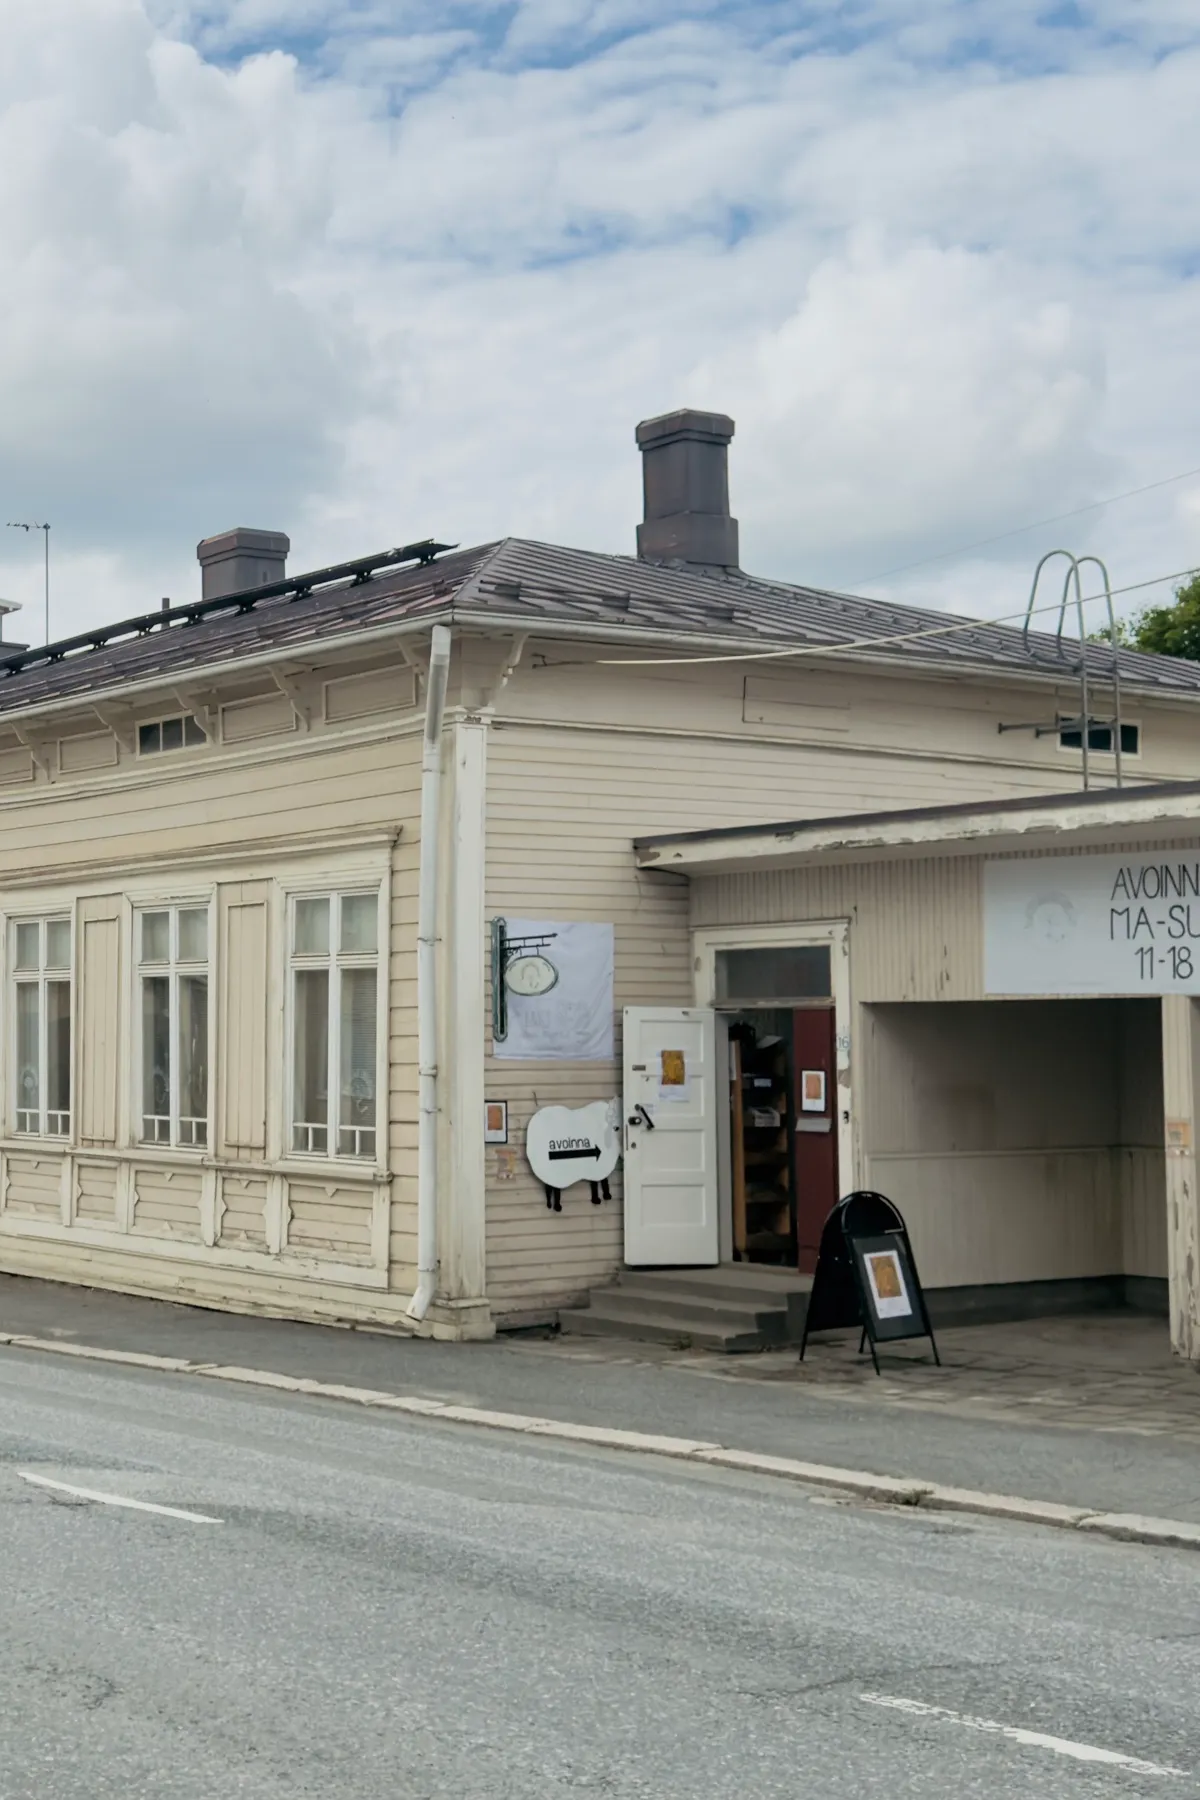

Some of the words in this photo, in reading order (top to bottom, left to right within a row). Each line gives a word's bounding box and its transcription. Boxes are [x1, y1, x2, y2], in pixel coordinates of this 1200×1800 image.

[1111, 863, 1200, 901] AVOINN
[1110, 904, 1200, 940] MA-SU
[1134, 945, 1194, 980] 11-18
[548, 1136, 591, 1150] avoinna
